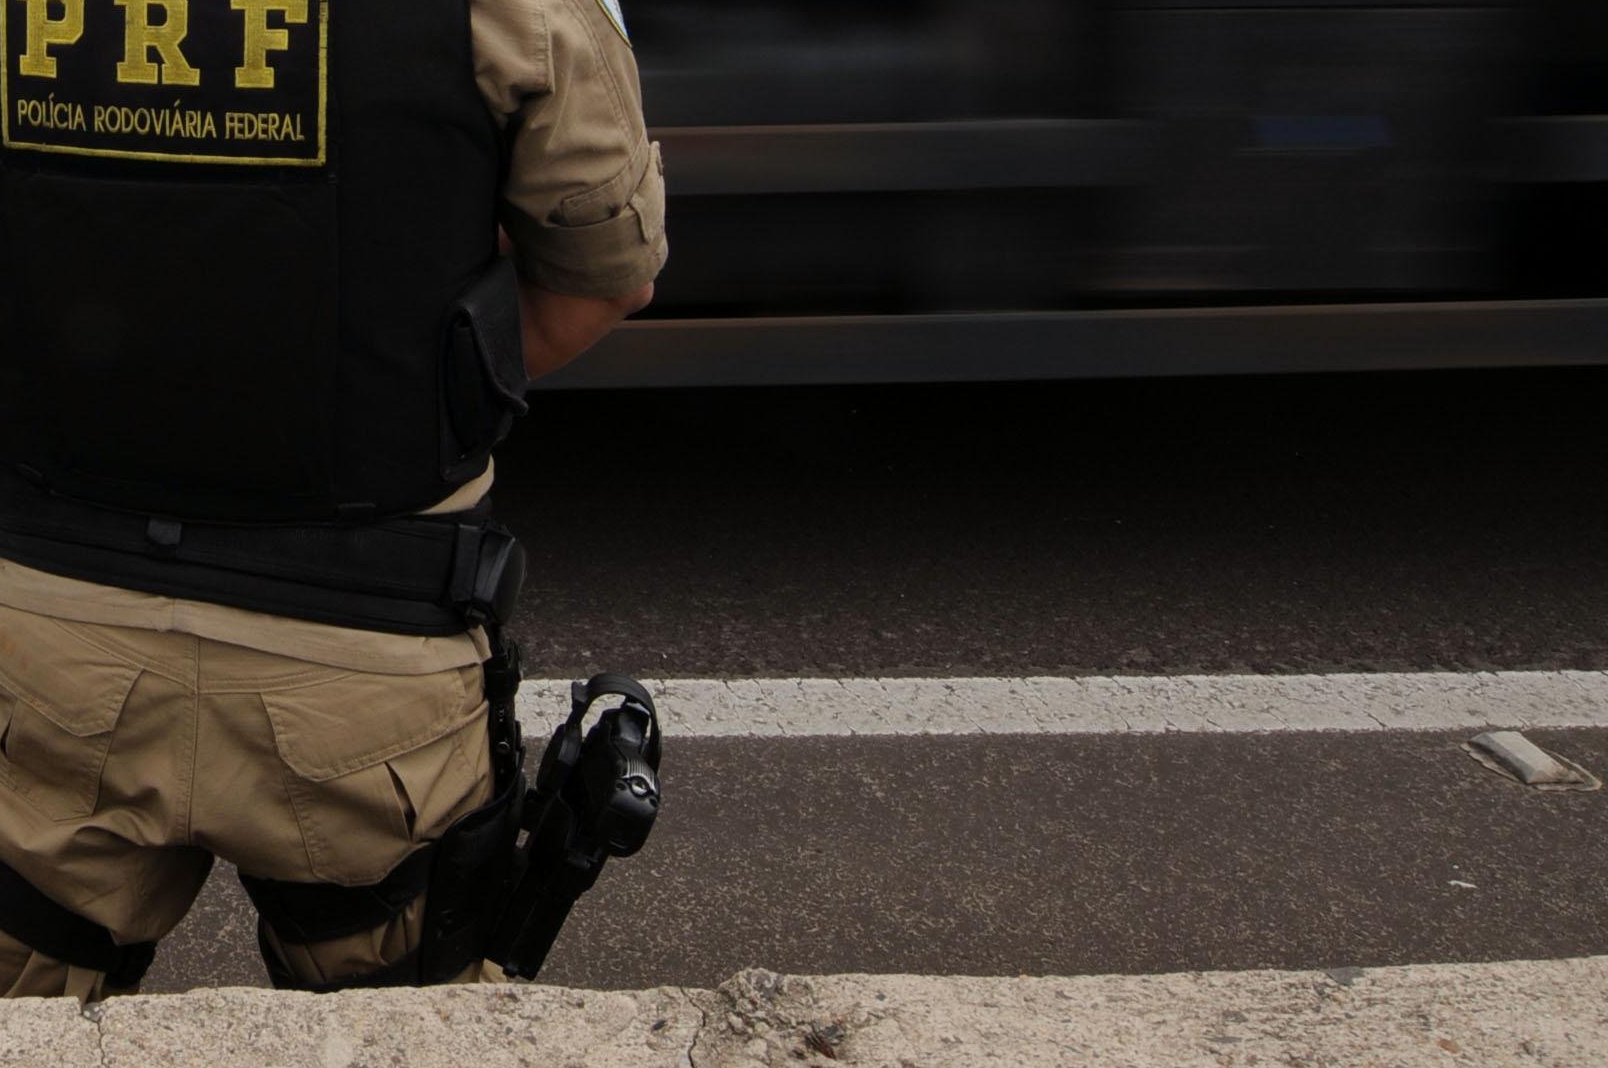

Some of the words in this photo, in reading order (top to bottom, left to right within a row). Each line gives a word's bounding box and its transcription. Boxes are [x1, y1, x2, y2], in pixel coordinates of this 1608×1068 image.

[17, 93, 87, 132] POLÍCIA
[94, 100, 217, 138] RODOVIÁRIA
[225, 112, 305, 141] FEDERAL
